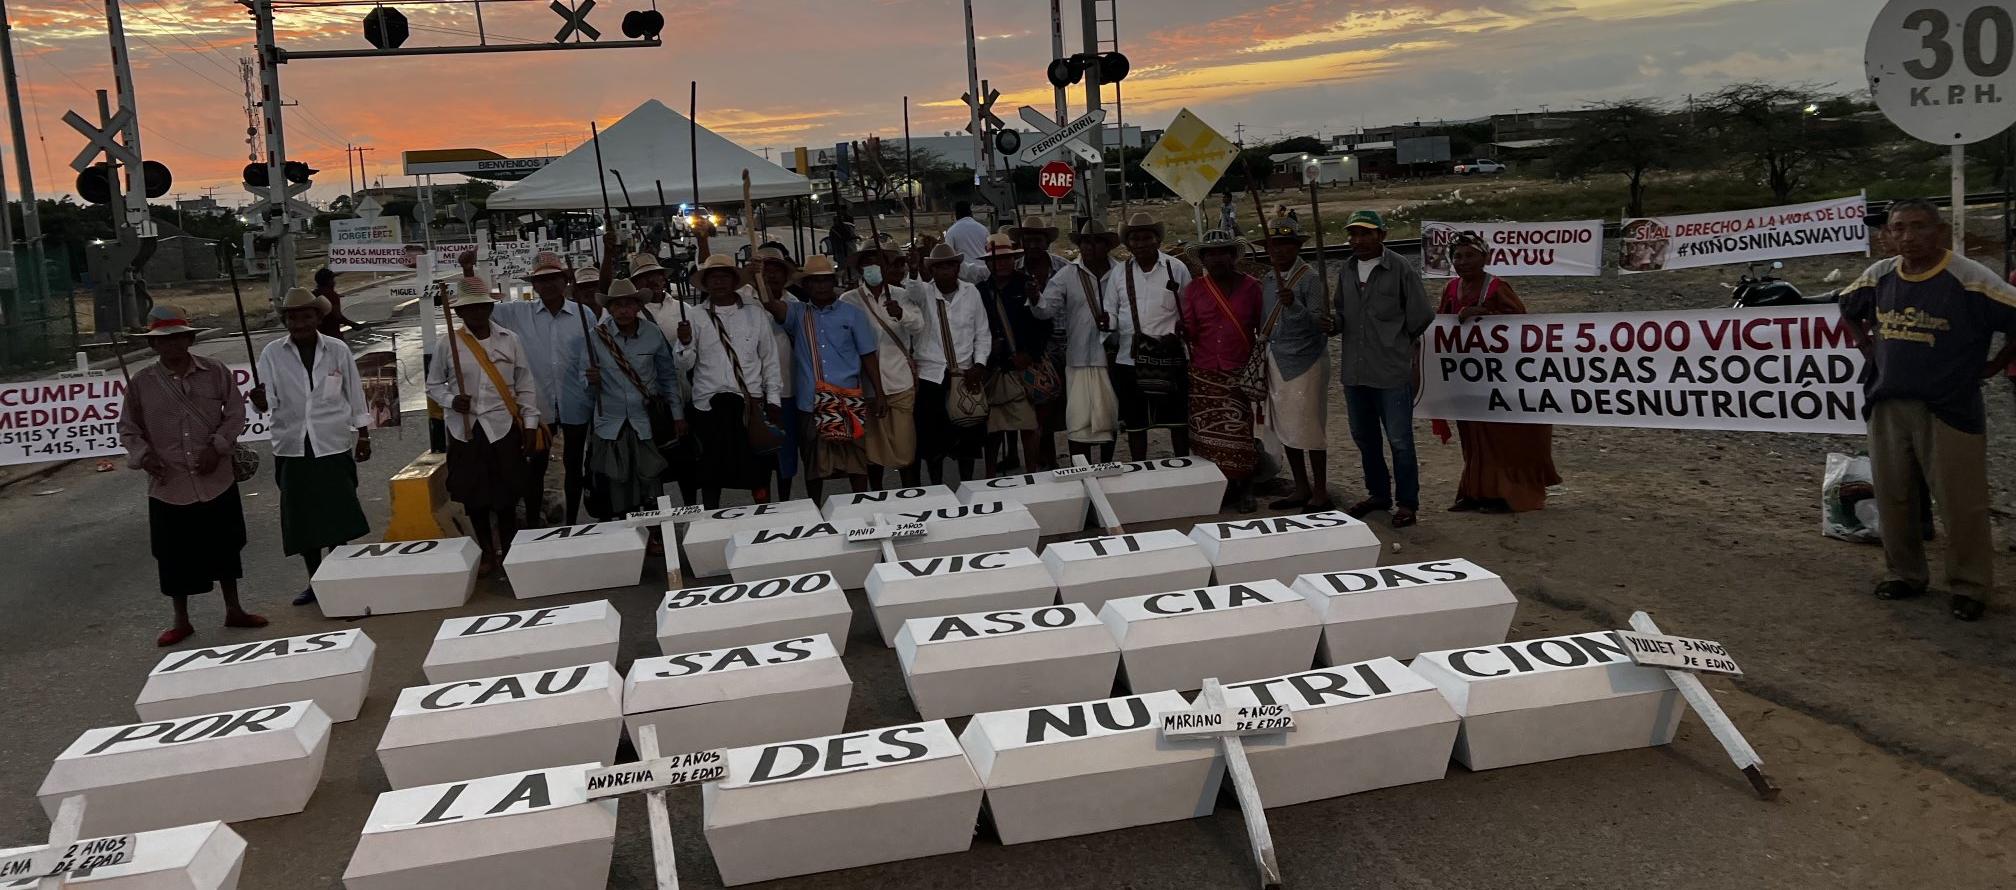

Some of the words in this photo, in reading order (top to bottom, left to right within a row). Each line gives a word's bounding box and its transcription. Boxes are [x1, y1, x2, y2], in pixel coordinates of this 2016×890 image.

[1902, 5, 2014, 80] 30
[1031, 115, 1096, 156] FERROCARRIL
[478, 159, 540, 170] BIENVENIDOS
[1041, 171, 1073, 188] PARE
[1675, 222, 1741, 238] DERECHO
[1745, 221, 1755, 231] A
[1759, 217, 1775, 228] LA
[1816, 208, 1834, 221] DE
[1838, 205, 1865, 219] LOS
[1493, 229, 1592, 244] GENOCIDIO
[1678, 224, 1866, 258] #NIÑOSNIÑASWAYUU
[330, 257, 348, 265] POR
[332, 248, 346, 256] NO
[368, 248, 407, 256] MUERTES
[390, 288, 417, 297] MIGUEL
[1434, 316, 1510, 353] MÁS
[1520, 323, 1564, 353] DE
[1574, 320, 1691, 353] 5.000
[1699, 316, 1859, 351] VICTIM
[1440, 357, 1508, 383] POR
[1515, 356, 1657, 384] CAUSAS
[1488, 387, 1512, 412] A
[1518, 388, 1563, 413] LA
[1571, 380, 1857, 420] DESNUTRICIÓN
[47, 427, 60, 440] Y
[22, 440, 80, 457] T-415,
[986, 474, 1036, 488] CI
[1055, 467, 1087, 476] VITELIO
[851, 488, 927, 505] NO
[711, 504, 778, 520] GE
[899, 501, 1003, 523] YUU
[533, 524, 603, 541] AL
[751, 522, 839, 544] WA
[848, 527, 875, 537] DAVID
[1217, 512, 1348, 539] MAS
[349, 540, 439, 558] NO
[1074, 535, 1140, 556] TI
[899, 551, 1010, 577] VIC
[1322, 562, 1468, 594] DAS
[1143, 584, 1275, 615] CIA
[459, 606, 570, 637] DE
[928, 605, 1077, 642] ASO
[159, 631, 347, 673] MAS
[1448, 632, 1628, 678] CION
[1626, 635, 1676, 657] YULIET
[1683, 639, 1693, 651] 3
[1694, 640, 1728, 657] AÑOS
[655, 637, 815, 678] SAS
[1683, 655, 1700, 667] DE
[1705, 657, 1736, 672] EDAD
[419, 665, 590, 711] CAU
[1227, 664, 1392, 706] TRI
[1025, 697, 1151, 744] NU
[1164, 713, 1222, 731] MARIANO
[1238, 707, 1249, 718] 4
[1251, 704, 1284, 718] AÑOS
[83, 704, 291, 756] POR
[1236, 719, 1253, 731] DE
[1257, 716, 1291, 730] EDAD
[670, 756, 681, 769] 2
[682, 751, 721, 767] AÑOS
[749, 726, 929, 783] DES
[587, 769, 654, 791] ANDREINA
[670, 771, 689, 785] DE
[690, 765, 724, 781] EDAD
[417, 772, 552, 825] LA
[63, 844, 79, 859] 2
[81, 836, 127, 856] AÑOS
[51, 858, 76, 874] DE
[79, 851, 125, 870] EDAD
